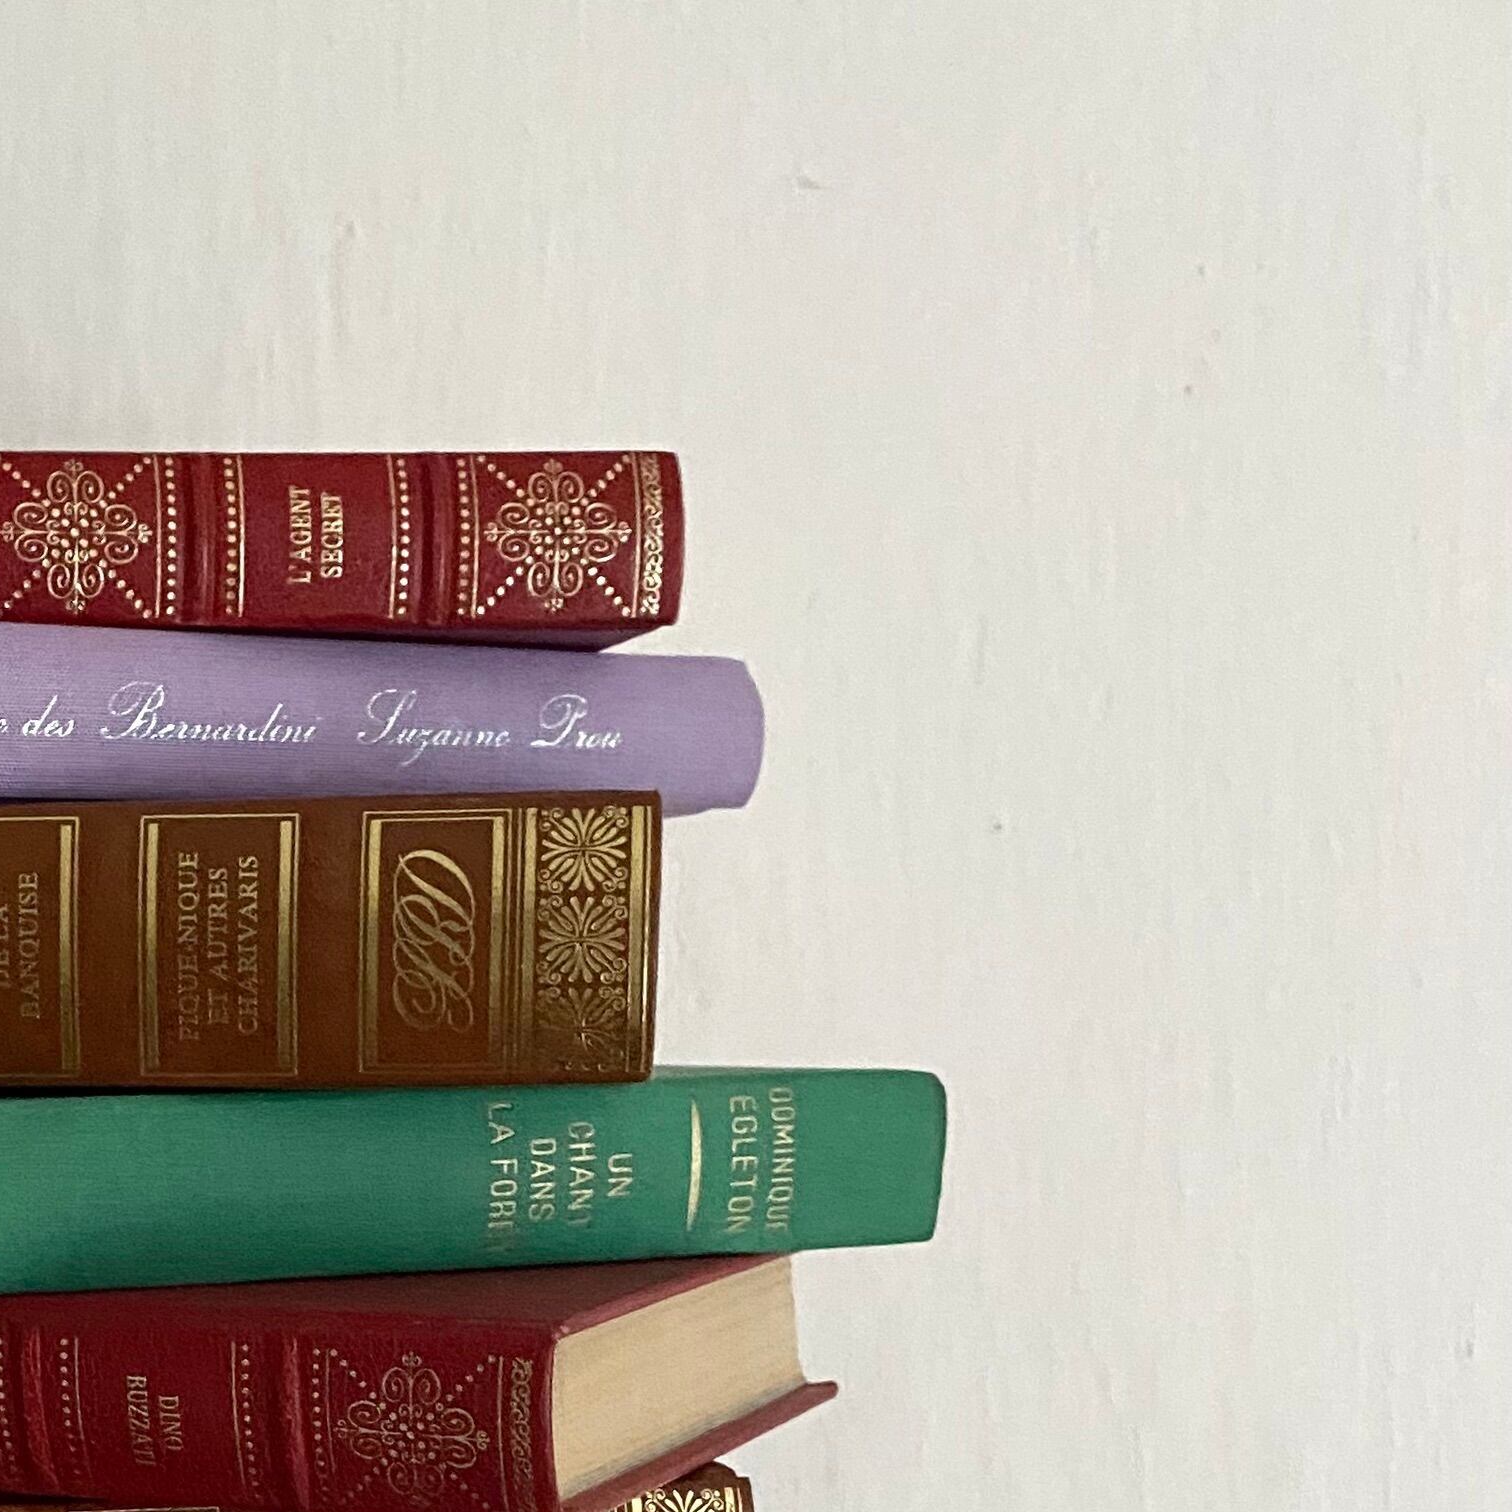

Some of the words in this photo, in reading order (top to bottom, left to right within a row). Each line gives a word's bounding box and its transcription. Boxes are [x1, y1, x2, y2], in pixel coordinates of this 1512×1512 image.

[287, 485, 312, 584] L'AGENT
[320, 491, 344, 578] SECRET
[22, 695, 75, 737] des
[100, 681, 323, 742] Bernardini
[357, 689, 511, 766] Suzanne
[531, 694, 623, 747] Prou
[19, 872, 41, 1020] BANQUISE
[208, 867, 228, 981] AUTRES
[238, 855, 258, 1034] CHARIVARIS
[208, 988, 229, 1024] ET
[488, 1103, 515, 1144] LA
[725, 1096, 759, 1233] EGLETON
[528, 1138, 557, 1222] DANS
[607, 1153, 633, 1197] UN
[159, 1395, 184, 1451] DINO
